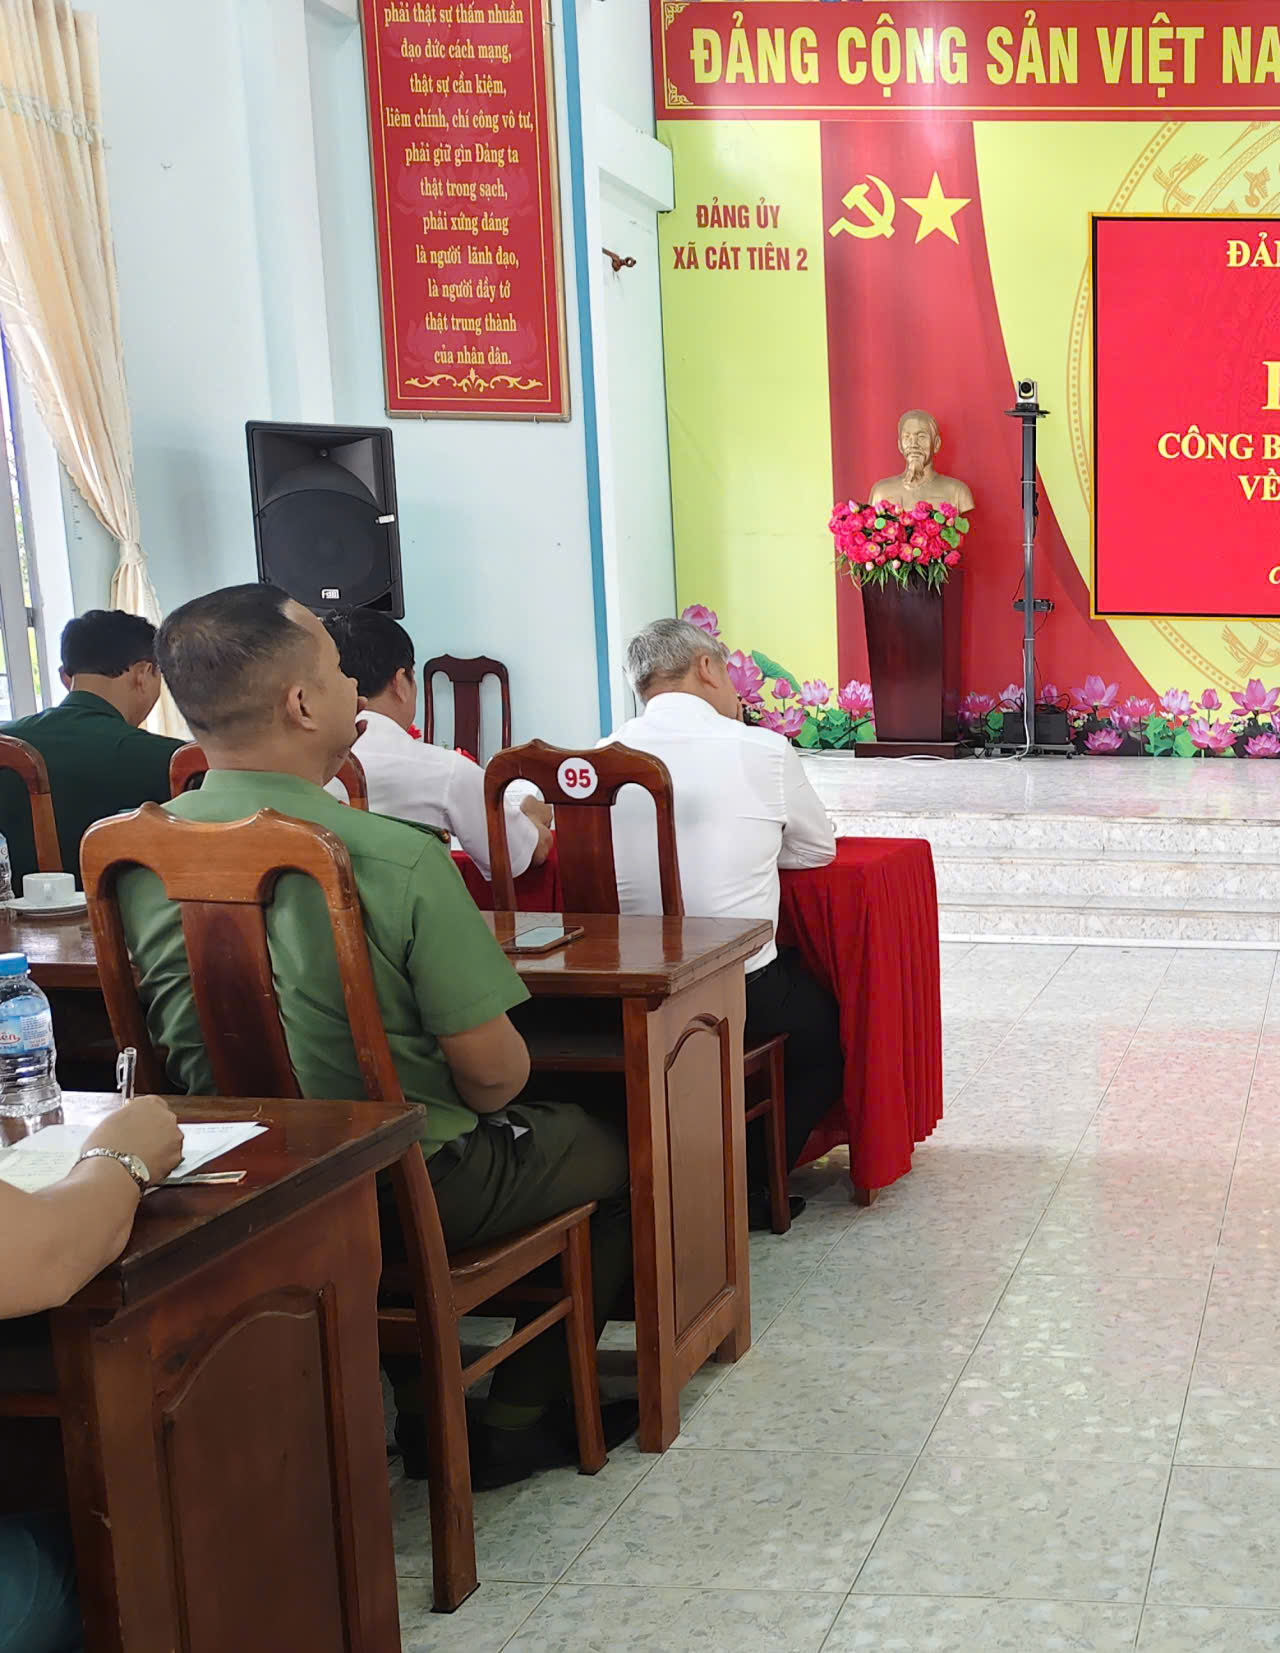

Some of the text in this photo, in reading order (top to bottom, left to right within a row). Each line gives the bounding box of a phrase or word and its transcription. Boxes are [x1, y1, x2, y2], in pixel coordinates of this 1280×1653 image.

[384, 0, 523, 28] phải thật sự thấm nhuần
[401, 38, 511, 63] đạo đức cách mạng,
[690, 11, 819, 85] ĐẢNG
[838, 13, 968, 97] CỘNG
[987, 10, 1077, 85] SẢN
[1096, 13, 1204, 98] VIỆT
[410, 71, 506, 97] thật sự cần kiệm,
[386, 108, 533, 133] liêm chính, chí công vô tư,
[406, 143, 518, 167] phải giữ gìn Đảng ta
[421, 177, 507, 201] thật trong sạch,
[423, 210, 508, 235] phải xứng đáng
[696, 196, 780, 229] ĐẢNG ỦY
[416, 245, 518, 268] là người lãnh đạo,
[673, 241, 808, 271] XÃ CÁT TIÊN 2
[428, 277, 510, 302] là người đầy tớ
[426, 312, 516, 335] thật trung thành
[435, 344, 511, 364] của nhân dân.
[1158, 425, 1254, 459] CÔNG
[1238, 468, 1280, 500] VỀ
[565, 768, 591, 788] 95
